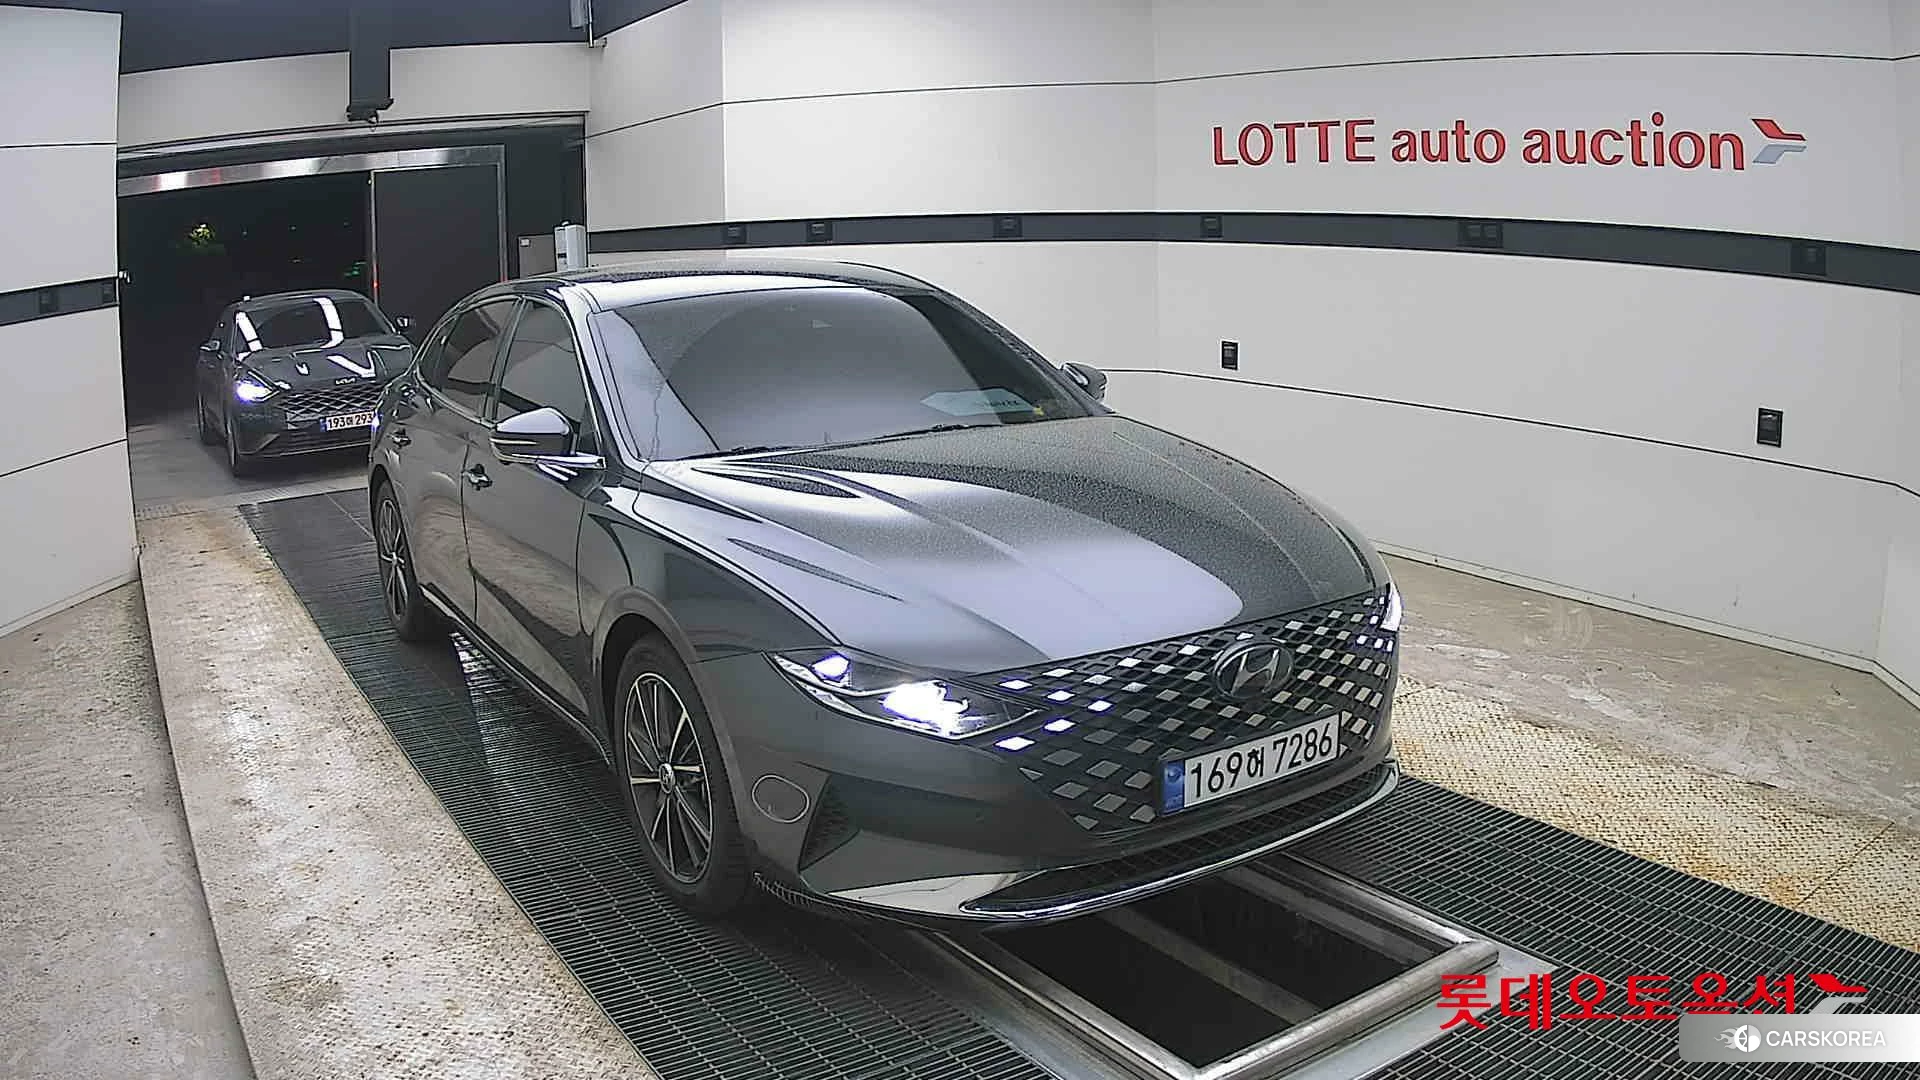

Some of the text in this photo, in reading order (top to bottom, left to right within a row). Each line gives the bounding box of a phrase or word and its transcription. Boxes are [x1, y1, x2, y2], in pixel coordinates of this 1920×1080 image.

[1213, 111, 1744, 171] LOTTE auto auction
[1190, 722, 1332, 798] 169허 7286
